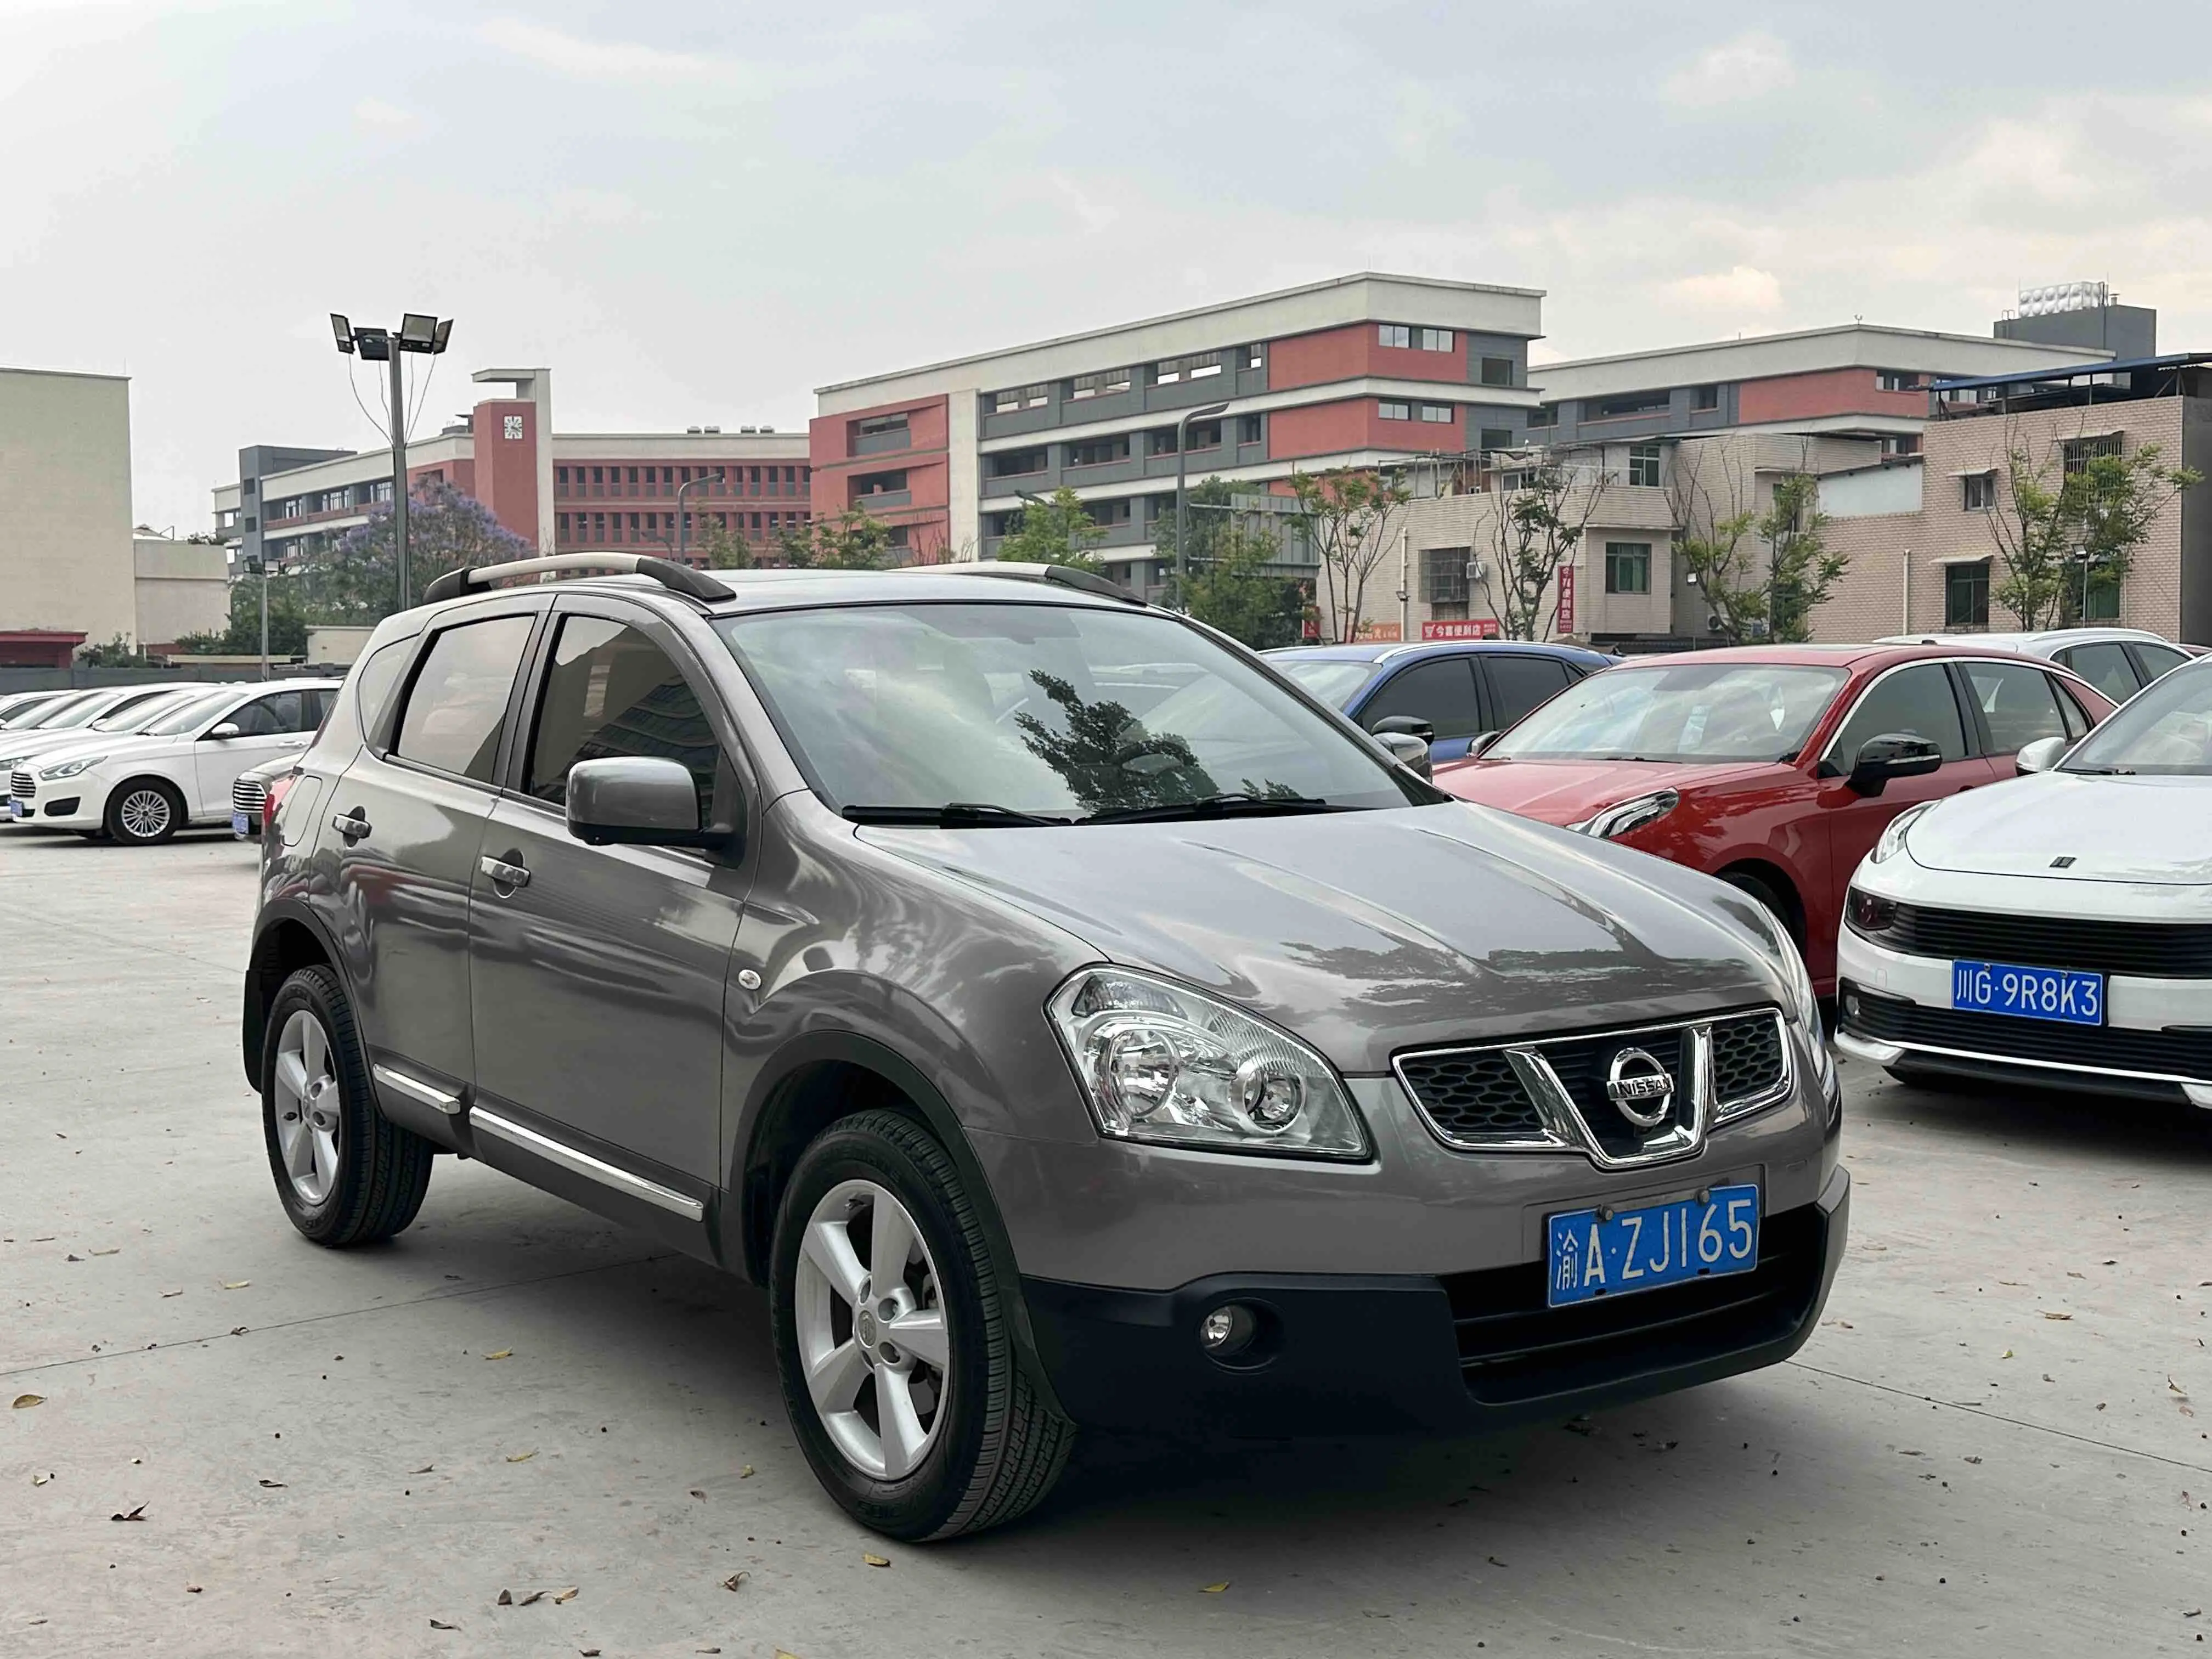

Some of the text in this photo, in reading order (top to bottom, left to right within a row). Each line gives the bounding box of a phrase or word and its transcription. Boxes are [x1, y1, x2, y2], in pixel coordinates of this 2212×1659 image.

[1956, 969, 2098, 1016] 川G·9R8K3
[1617, 1077, 1671, 1096] NISSAN
[1555, 1199, 1752, 1291] 渝A·ZJ165
